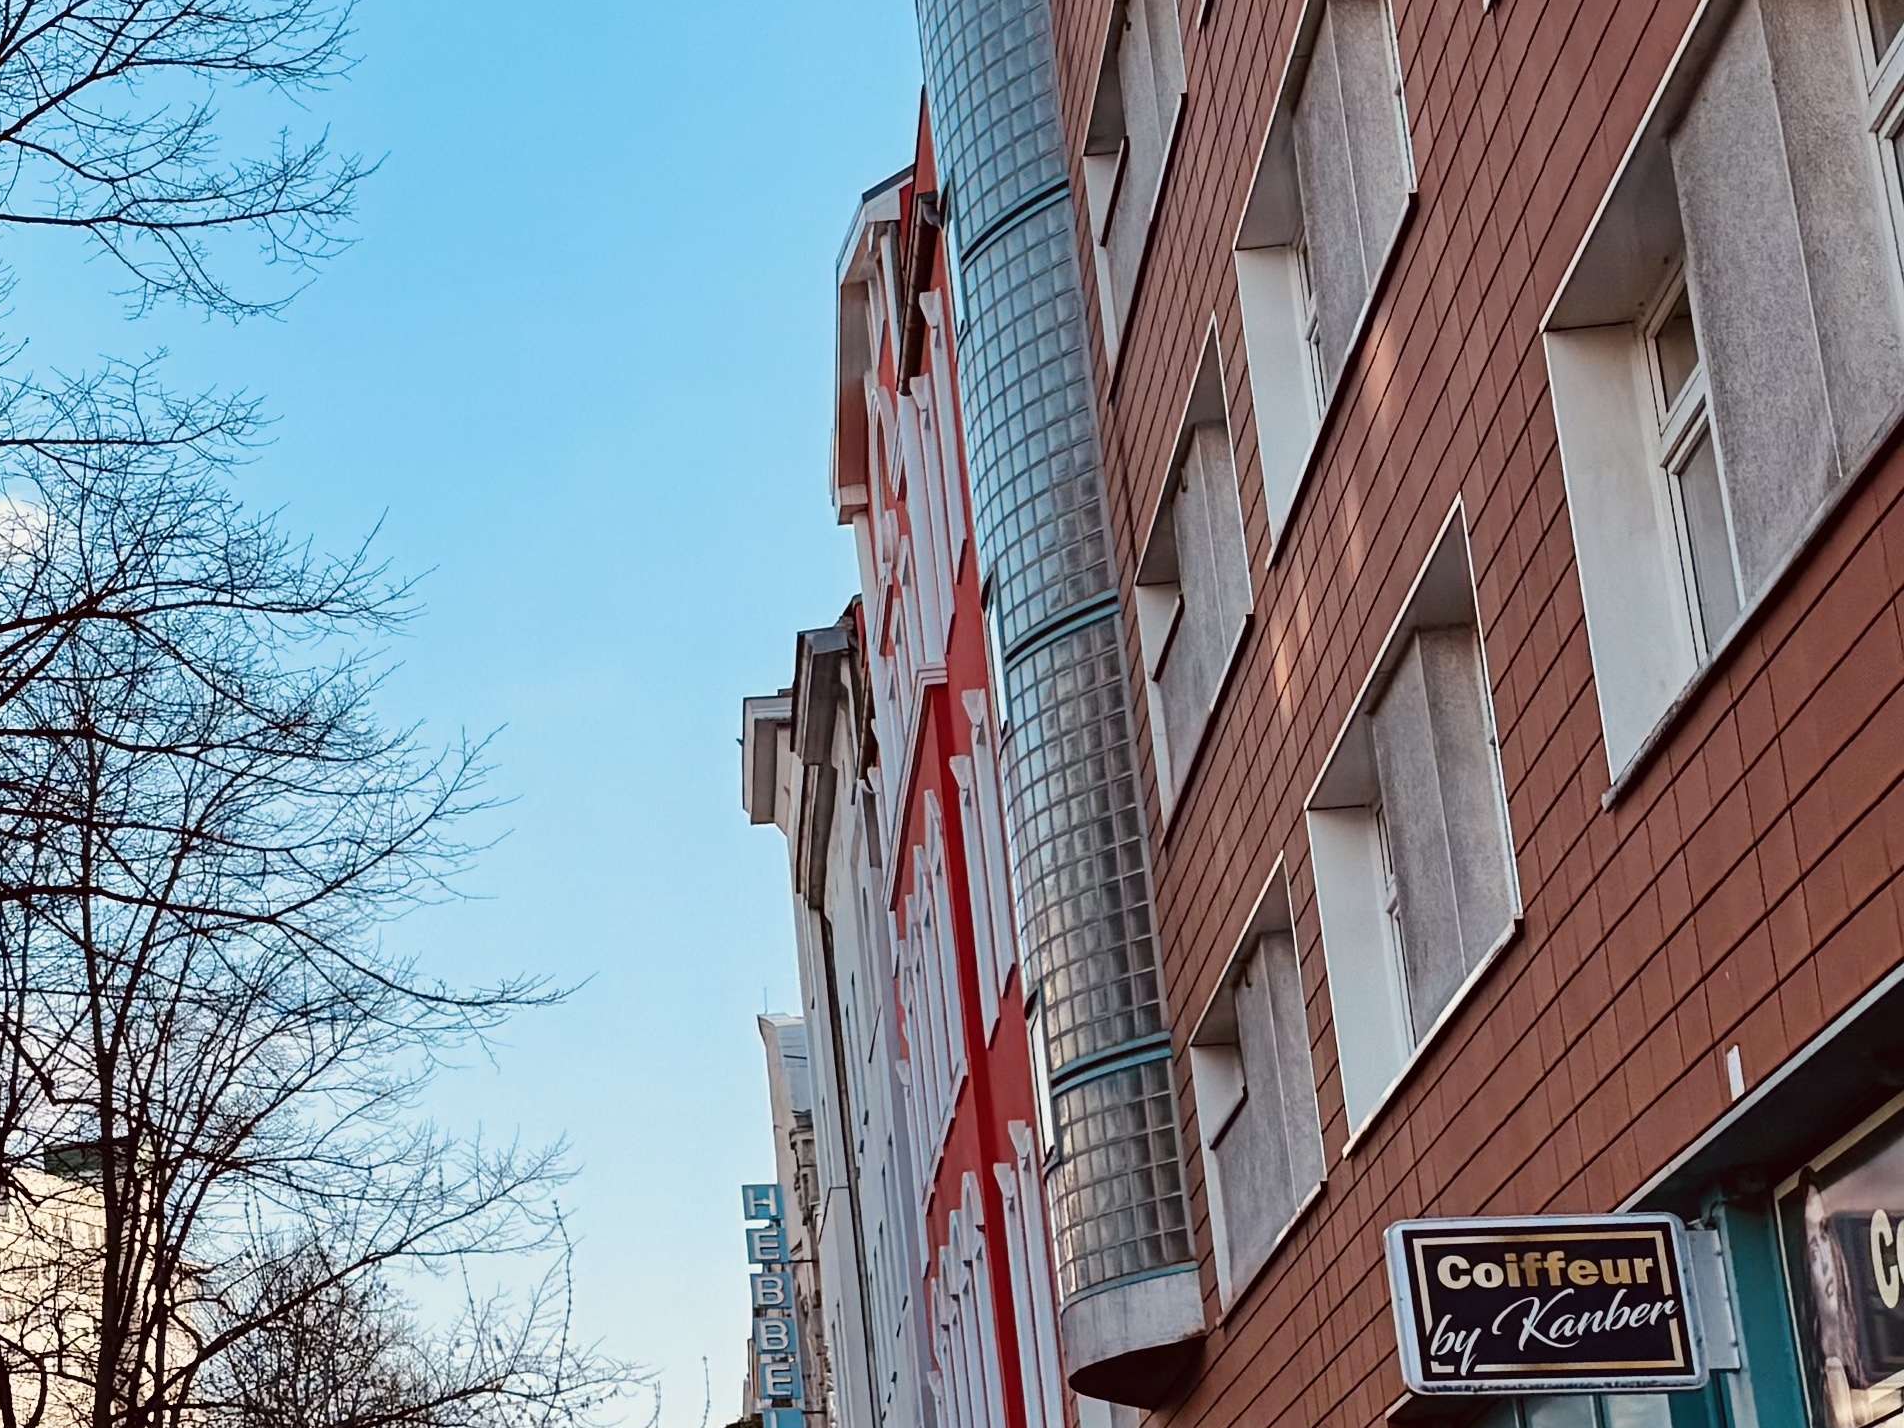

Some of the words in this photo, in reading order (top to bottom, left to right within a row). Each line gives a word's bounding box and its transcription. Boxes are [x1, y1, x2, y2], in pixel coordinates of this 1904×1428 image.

[1436, 1250, 1654, 1290] Coiffeur
[1430, 1314, 1482, 1377] by
[1491, 1288, 1679, 1352] Kanber
